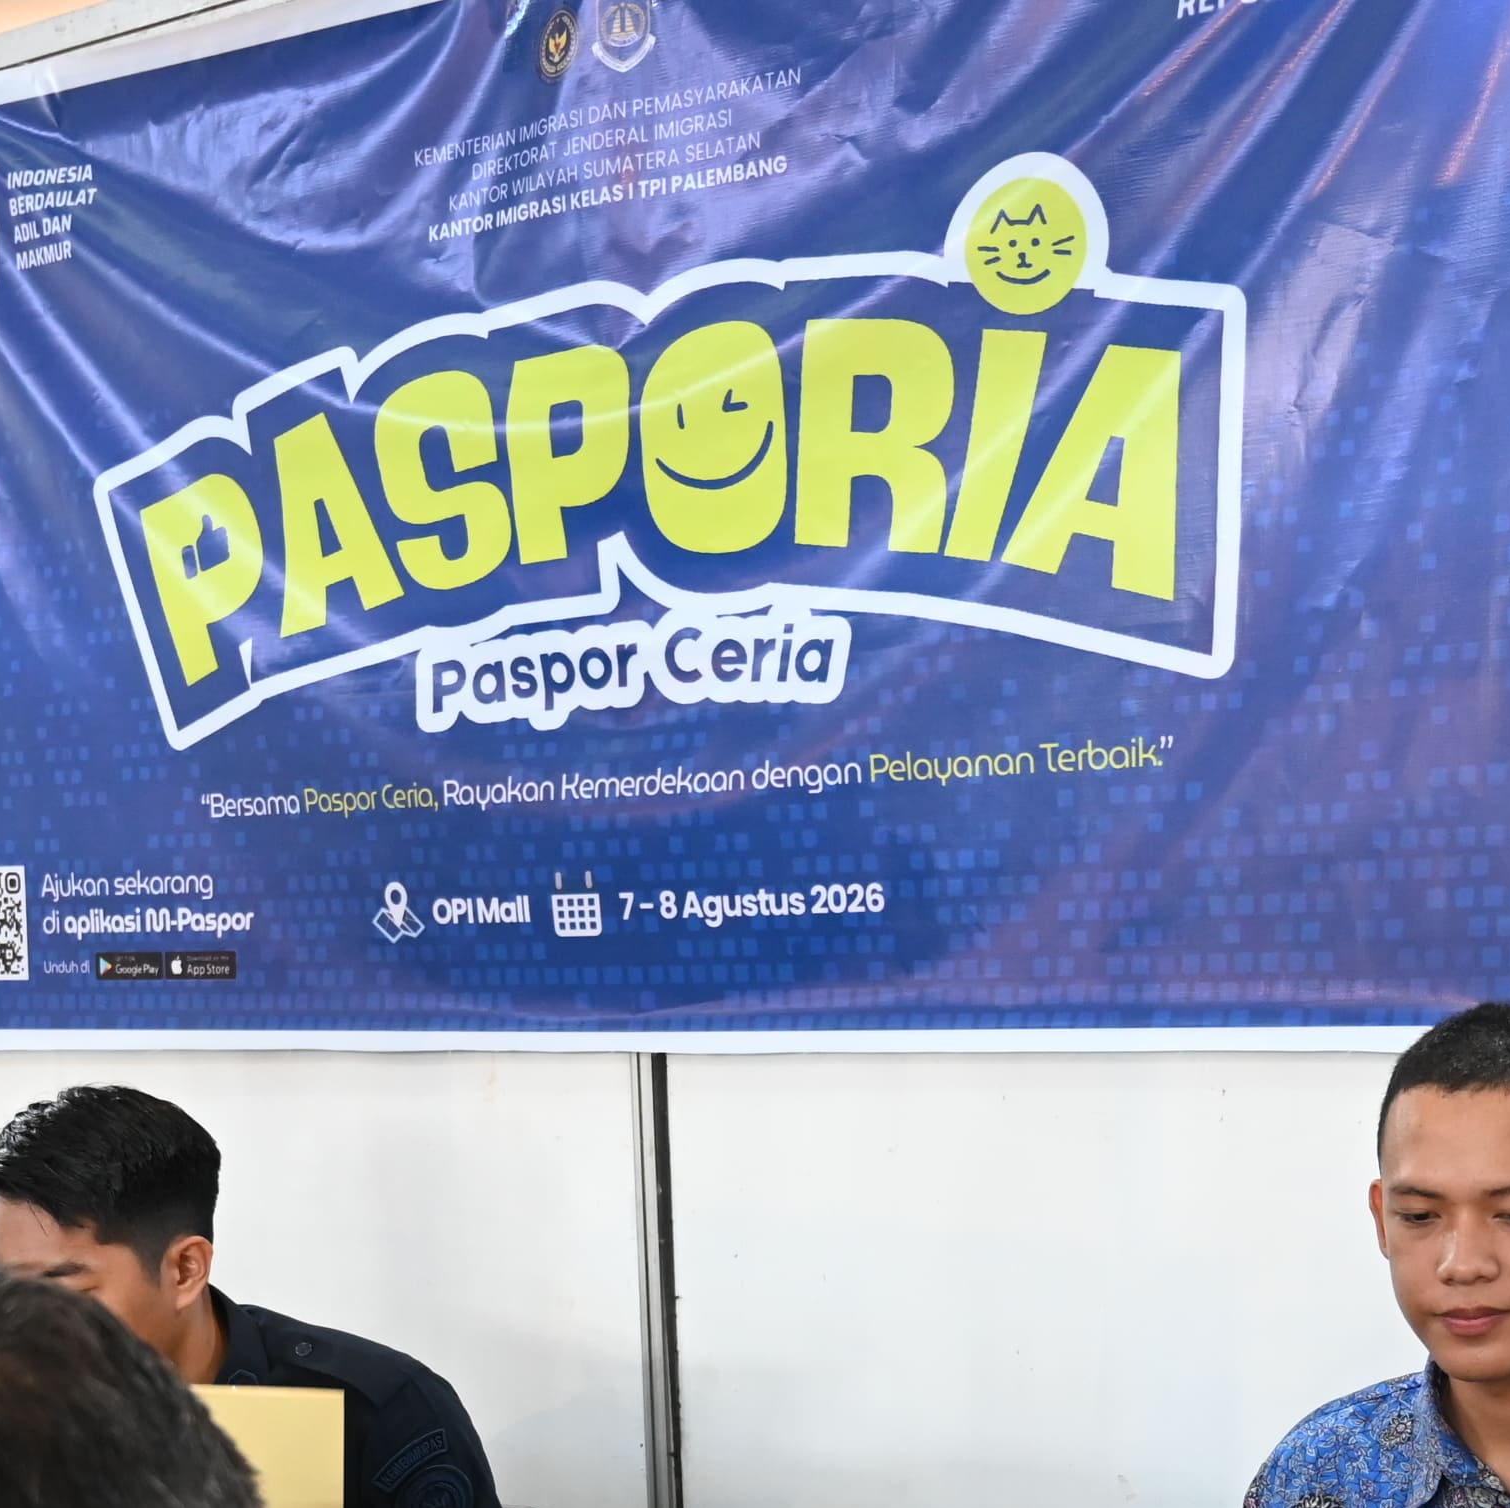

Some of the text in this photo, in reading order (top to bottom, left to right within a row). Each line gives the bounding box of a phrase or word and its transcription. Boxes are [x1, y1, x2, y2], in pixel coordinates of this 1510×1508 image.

[413, 67, 802, 168] KEMENTERIAN IMIGRASI DAN PEMASYARAKATAN
[471, 108, 733, 182] DIREKTORAT JENDERAL IMIGRASI
[7, 164, 93, 190] INDONESIA
[448, 131, 762, 213] KANTOR WILAYAH SUMATERA SELATAN
[8, 187, 98, 217] BERDAULAT
[428, 155, 788, 243] KANTOR IMIGRASI KELAS I TPI PALEMBANG
[13, 214, 73, 244] ADIL DAN
[16, 240, 73, 271] MAKMUR
[138, 317, 1182, 688] PASPORIA
[431, 628, 834, 717] Paspor Ceria
[304, 786, 377, 819] Paspor
[381, 781, 439, 813] Ceria,
[443, 775, 556, 810] Rayakan
[560, 763, 745, 801] Kemerdekaan
[751, 759, 862, 794] dengan
[870, 750, 1034, 786] Pelayanan
[41, 870, 214, 901] Ajukan sekarang
[432, 895, 531, 925] OPI Mall
[618, 892, 634, 920] 7
[659, 890, 677, 919] 8
[681, 886, 806, 928] Agustus
[810, 882, 886, 914] 2026
[42, 908, 255, 940] di aplikasi M-Paspor
[43, 960, 91, 975] Unduh di
[115, 963, 160, 977] Google Play
[186, 963, 230, 977] App Store
